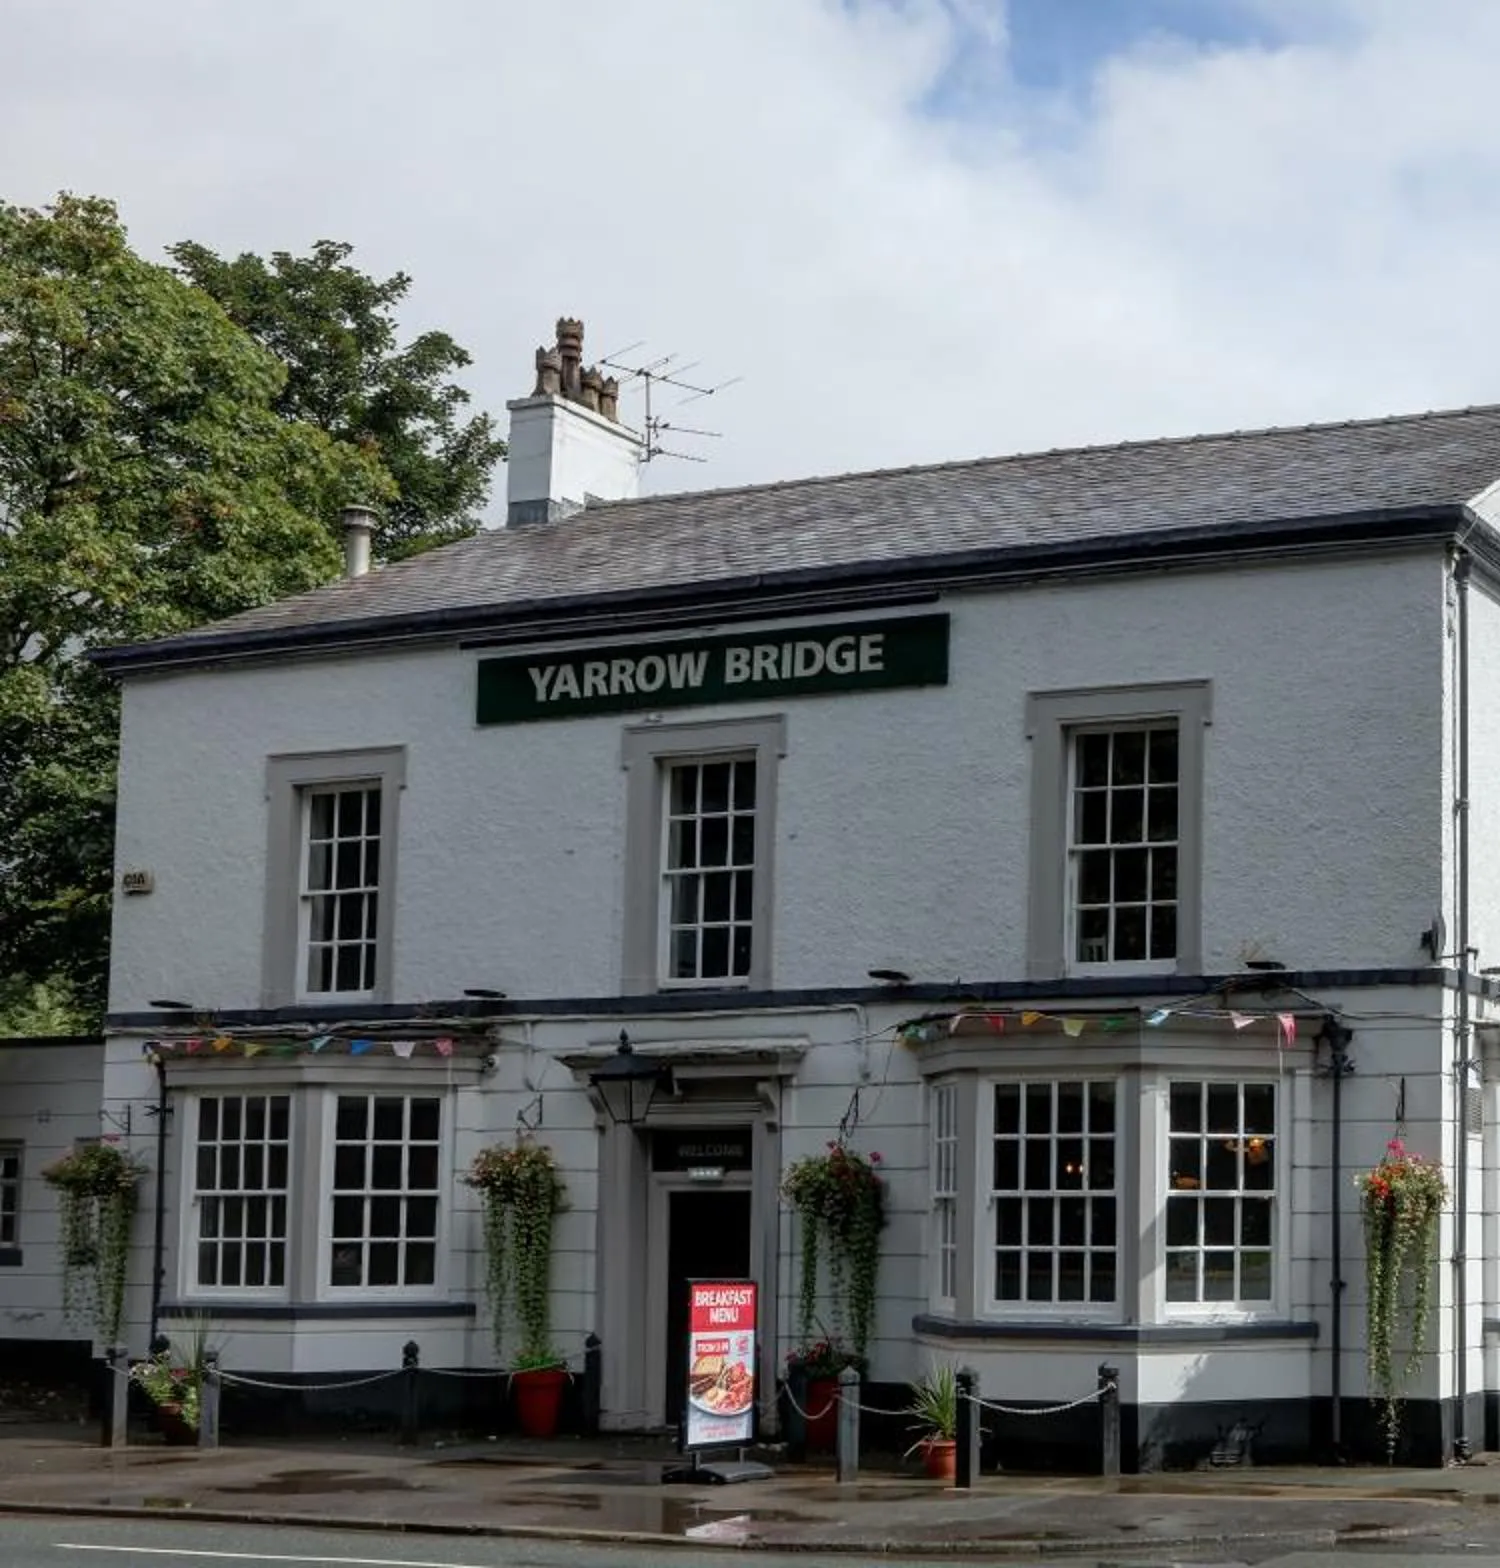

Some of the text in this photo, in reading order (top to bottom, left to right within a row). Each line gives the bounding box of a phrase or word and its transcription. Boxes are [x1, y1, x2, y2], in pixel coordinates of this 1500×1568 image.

[528, 634, 885, 702] YARROW BRIDGE
[695, 1289, 752, 1307] BREAKFAST
[709, 1307, 739, 1324] MENU
